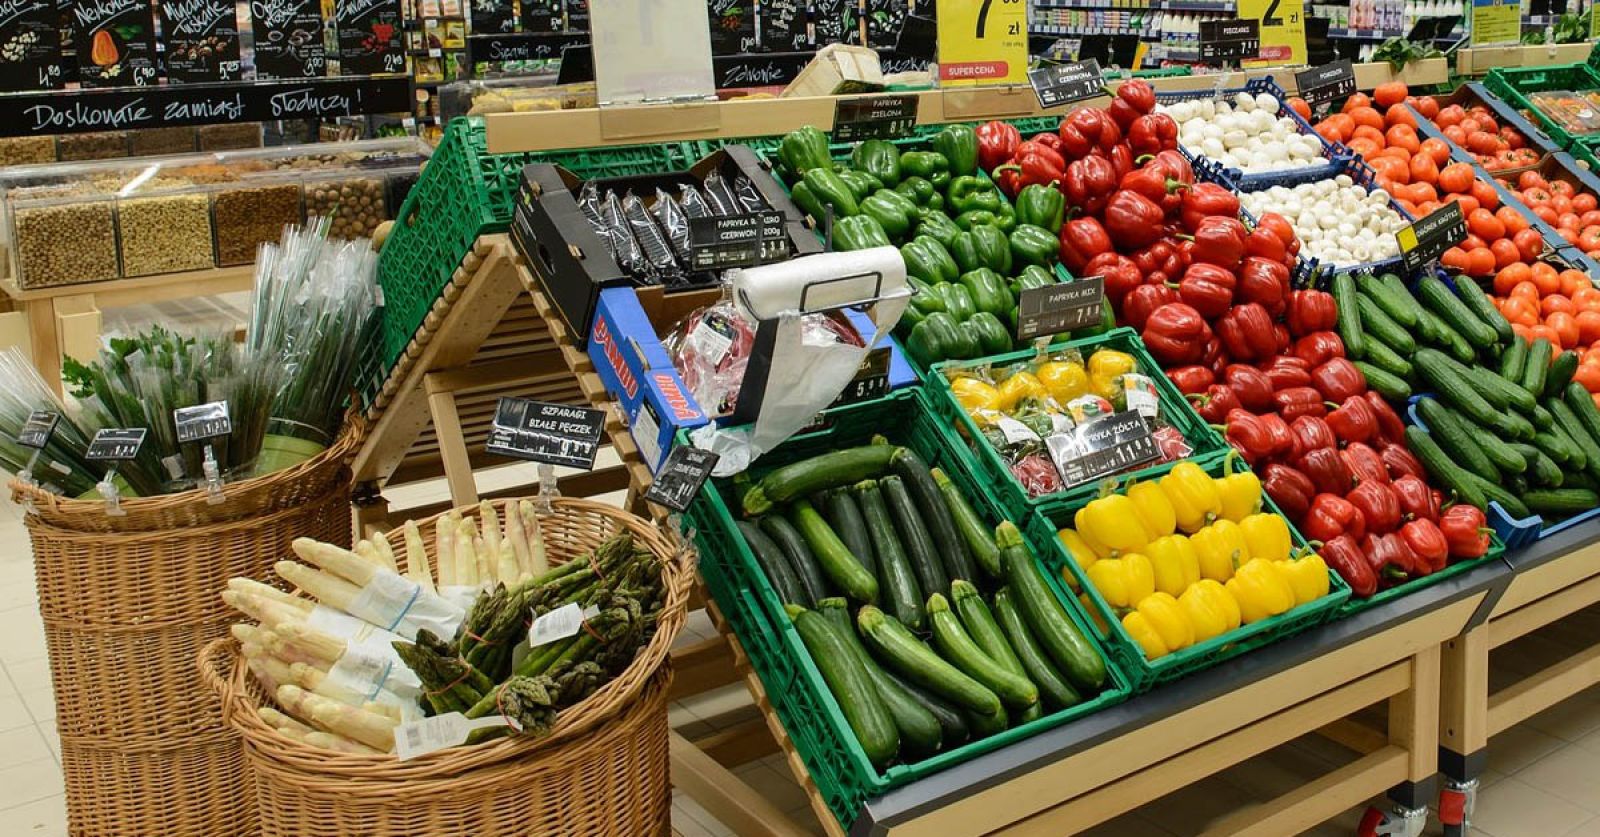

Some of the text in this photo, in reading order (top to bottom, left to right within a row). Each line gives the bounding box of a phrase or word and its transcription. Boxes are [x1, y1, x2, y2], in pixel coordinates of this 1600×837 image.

[1008, 20, 1020, 35] zł
[948, 65, 996, 76] SUPER CENA
[163, 92, 247, 121] zamiast
[872, 99, 902, 107] PAPRYKA
[871, 110, 902, 118] ZIELONA
[718, 218, 749, 229] PAPRYKA
[763, 227, 781, 236] 200g
[1049, 287, 1096, 303] PAPRYKA MIX
[541, 406, 588, 420] SZPARAGI
[528, 418, 593, 435] BIAŁE PĘCZEK
[1112, 419, 1142, 435] ŻÓŁTA
